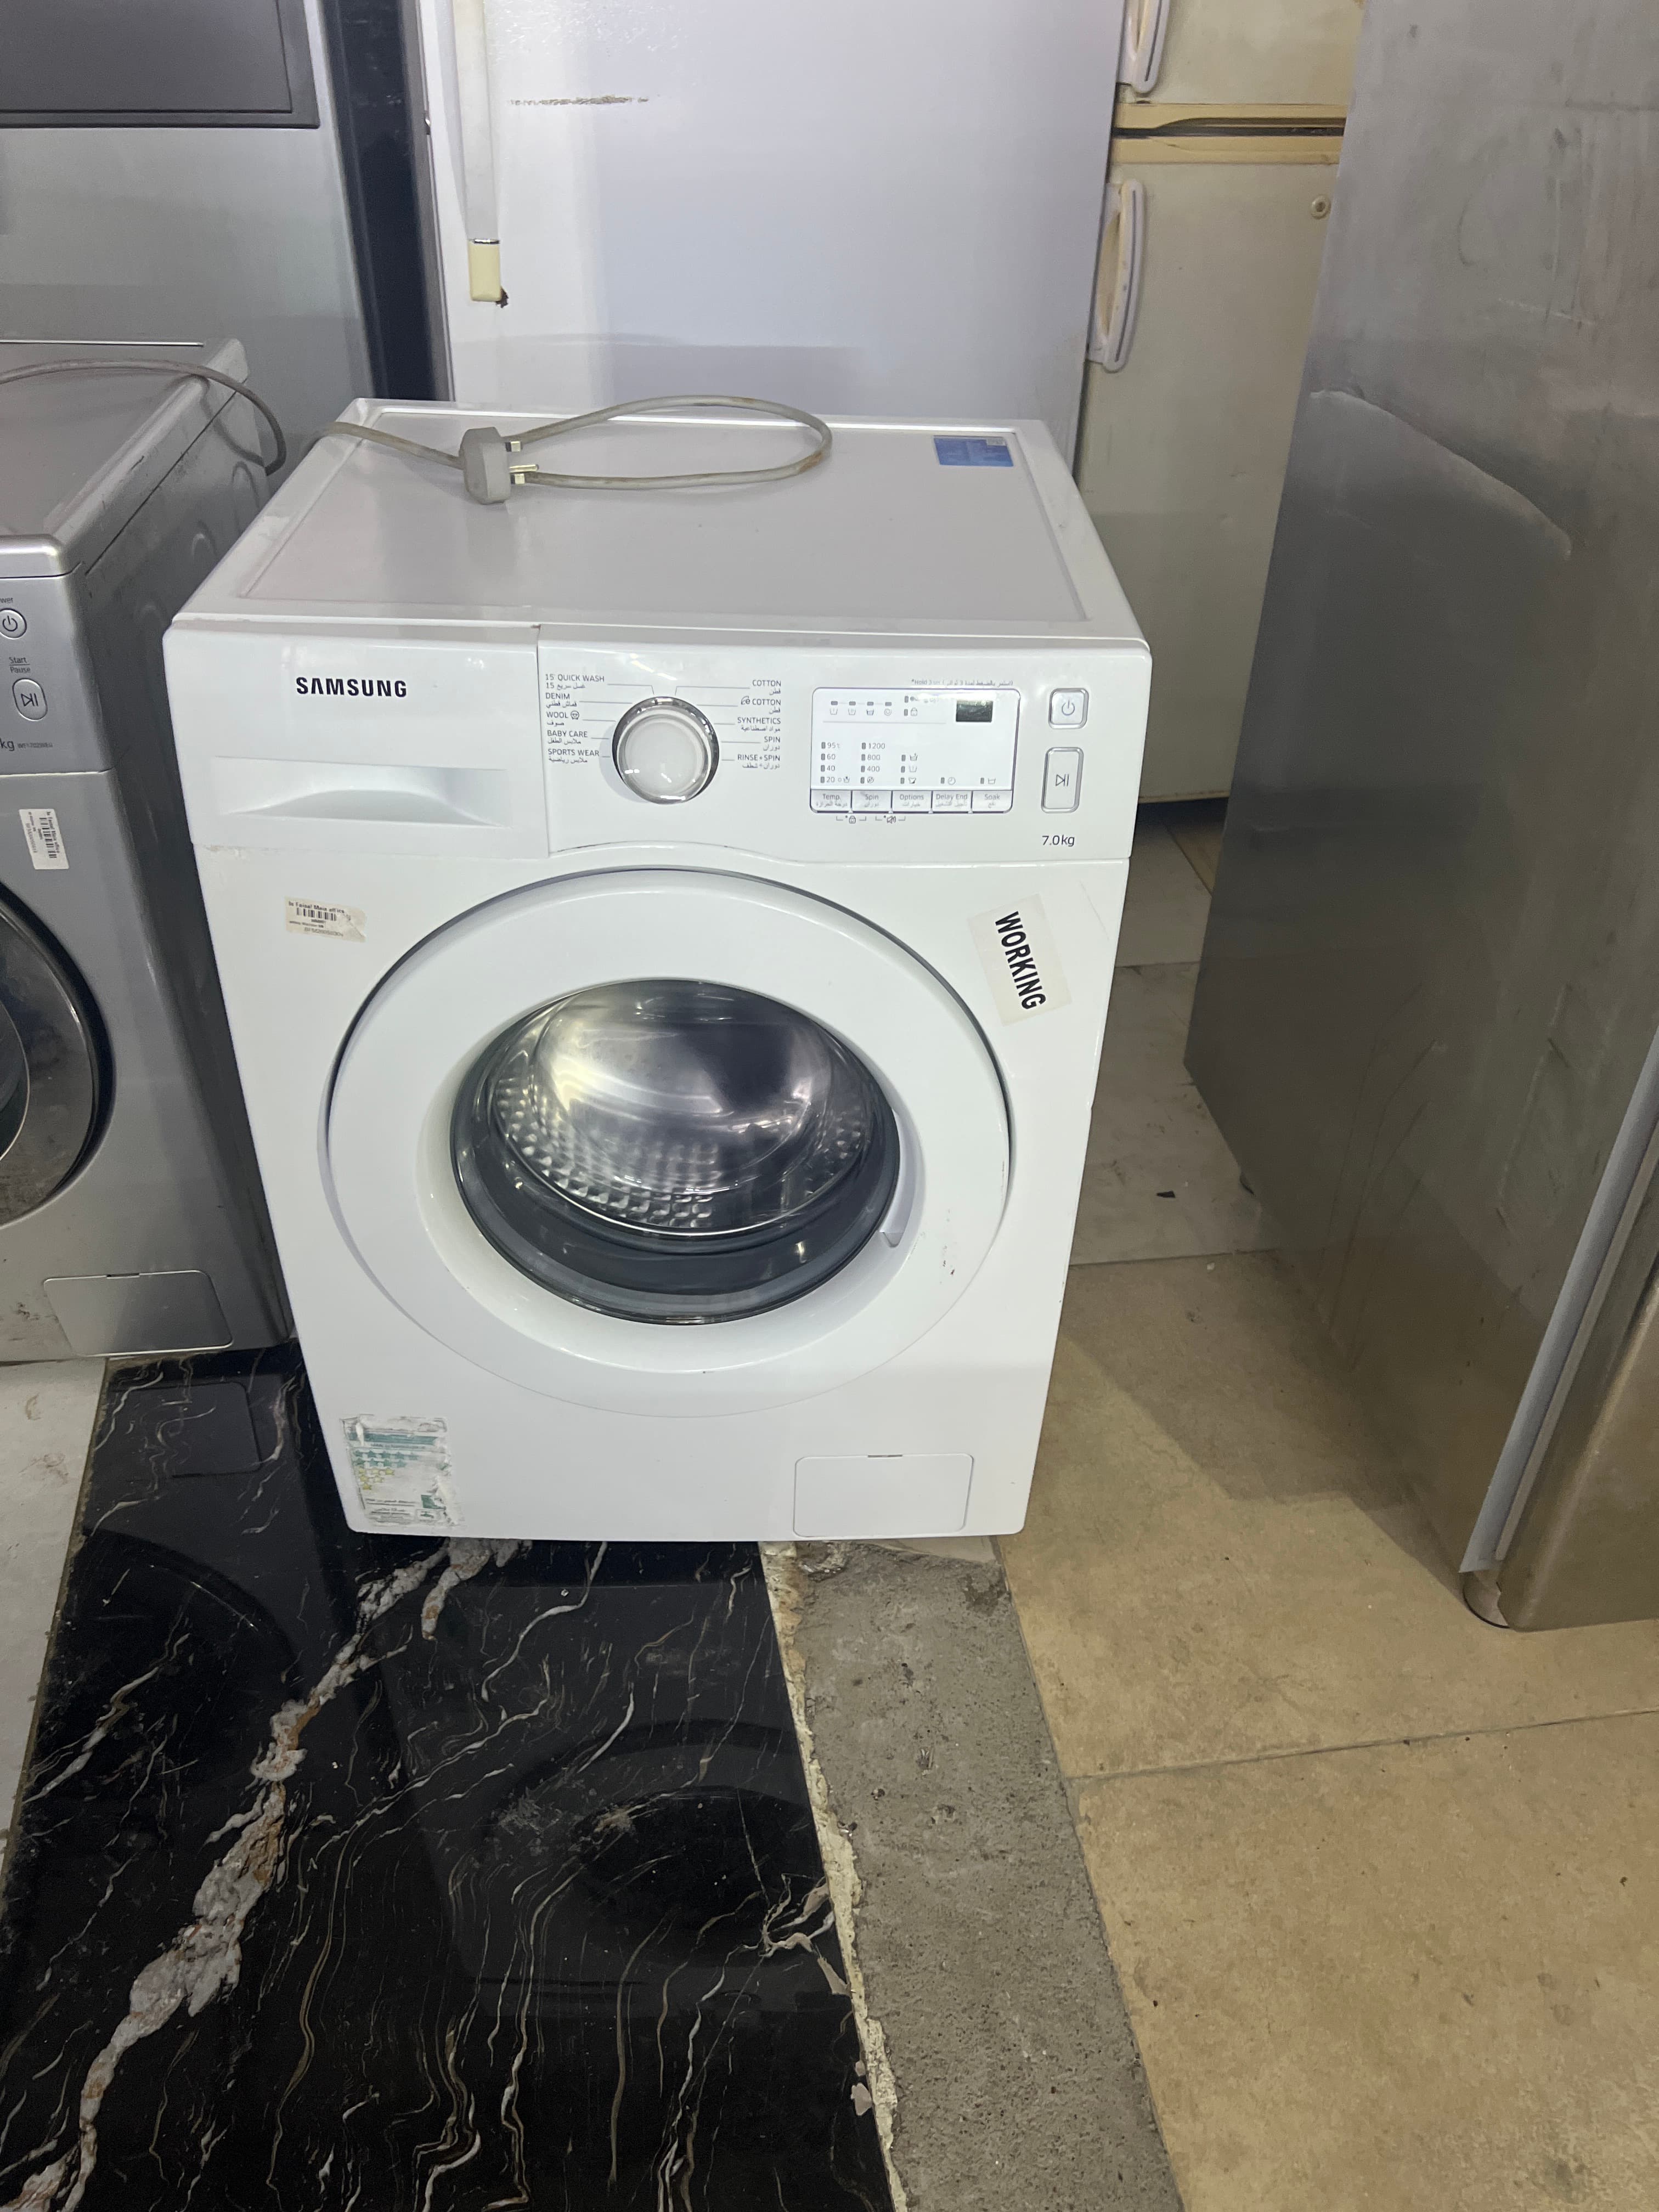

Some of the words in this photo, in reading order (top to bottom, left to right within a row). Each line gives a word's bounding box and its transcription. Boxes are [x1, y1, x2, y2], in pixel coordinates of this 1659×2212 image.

[296, 676, 407, 698] SAMSUNG
[737, 716, 781, 725] SYNTHETICS
[0, 737, 14, 751] kg
[823, 793, 842, 802] Temp.
[899, 793, 924, 802] Options
[995, 911, 1046, 1009] WORKING
